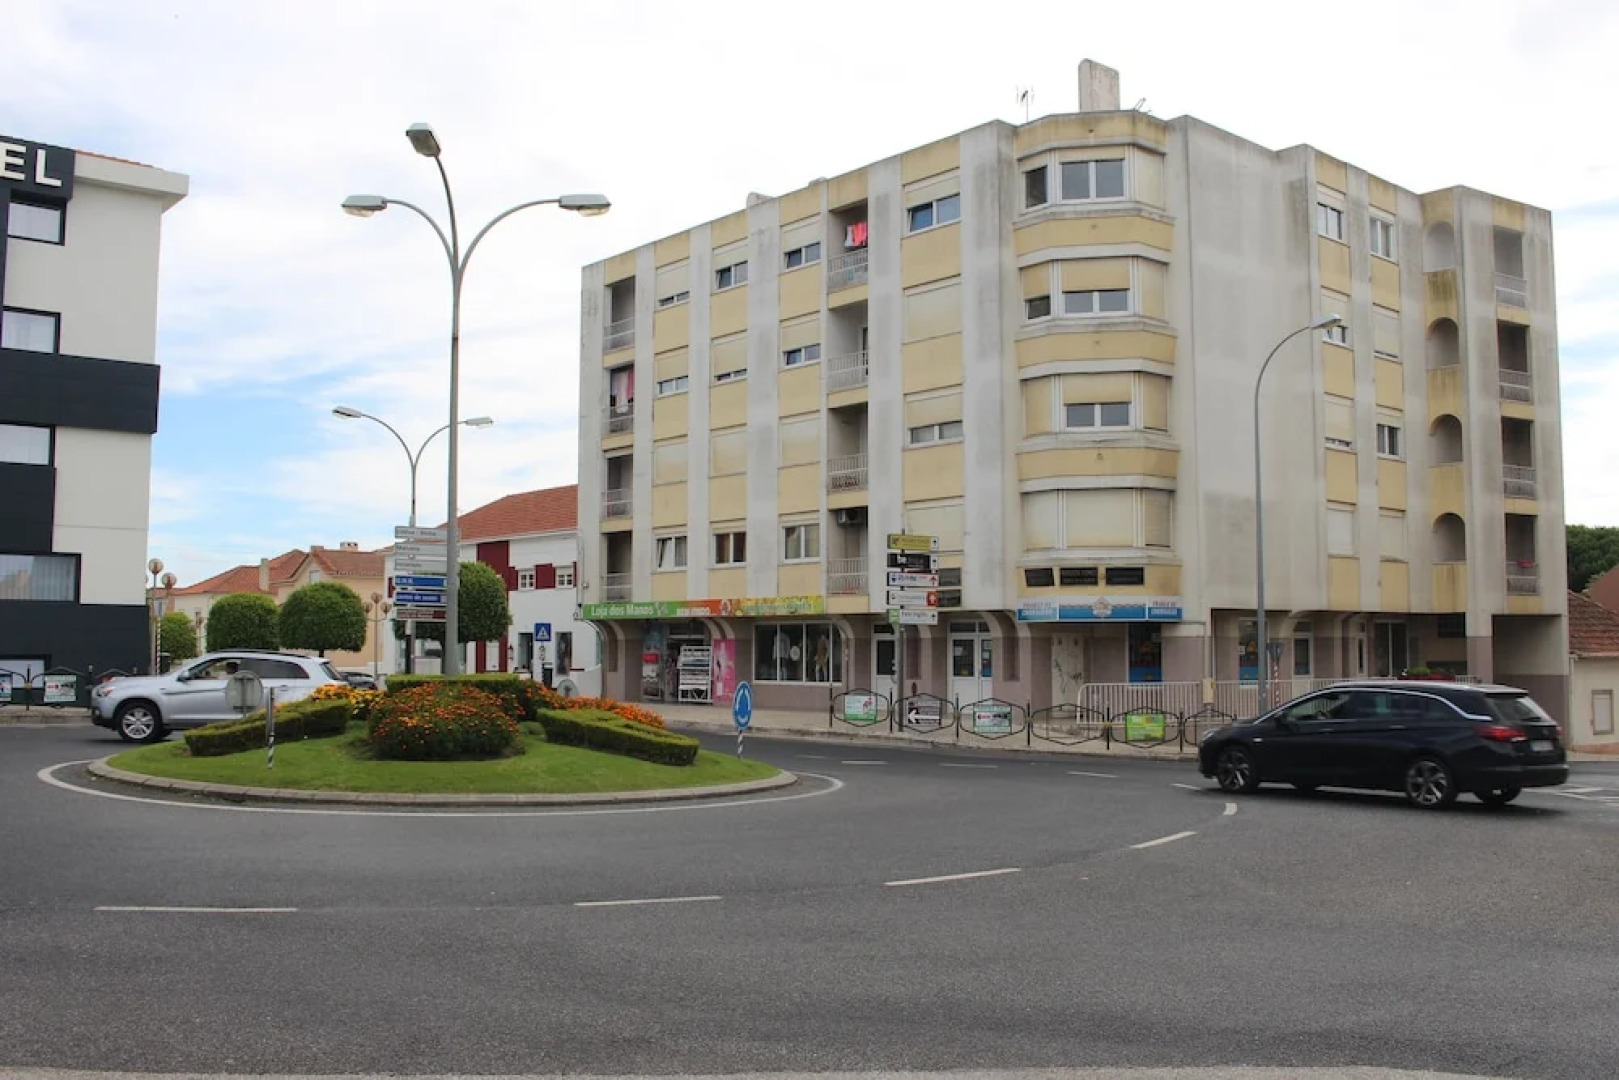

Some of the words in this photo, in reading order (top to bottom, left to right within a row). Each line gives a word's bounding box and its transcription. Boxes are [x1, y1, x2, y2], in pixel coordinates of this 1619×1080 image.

[0, 140, 63, 187] EL
[591, 605, 608, 619] Loja
[609, 604, 624, 616] dos
[626, 603, 654, 615] Manos
